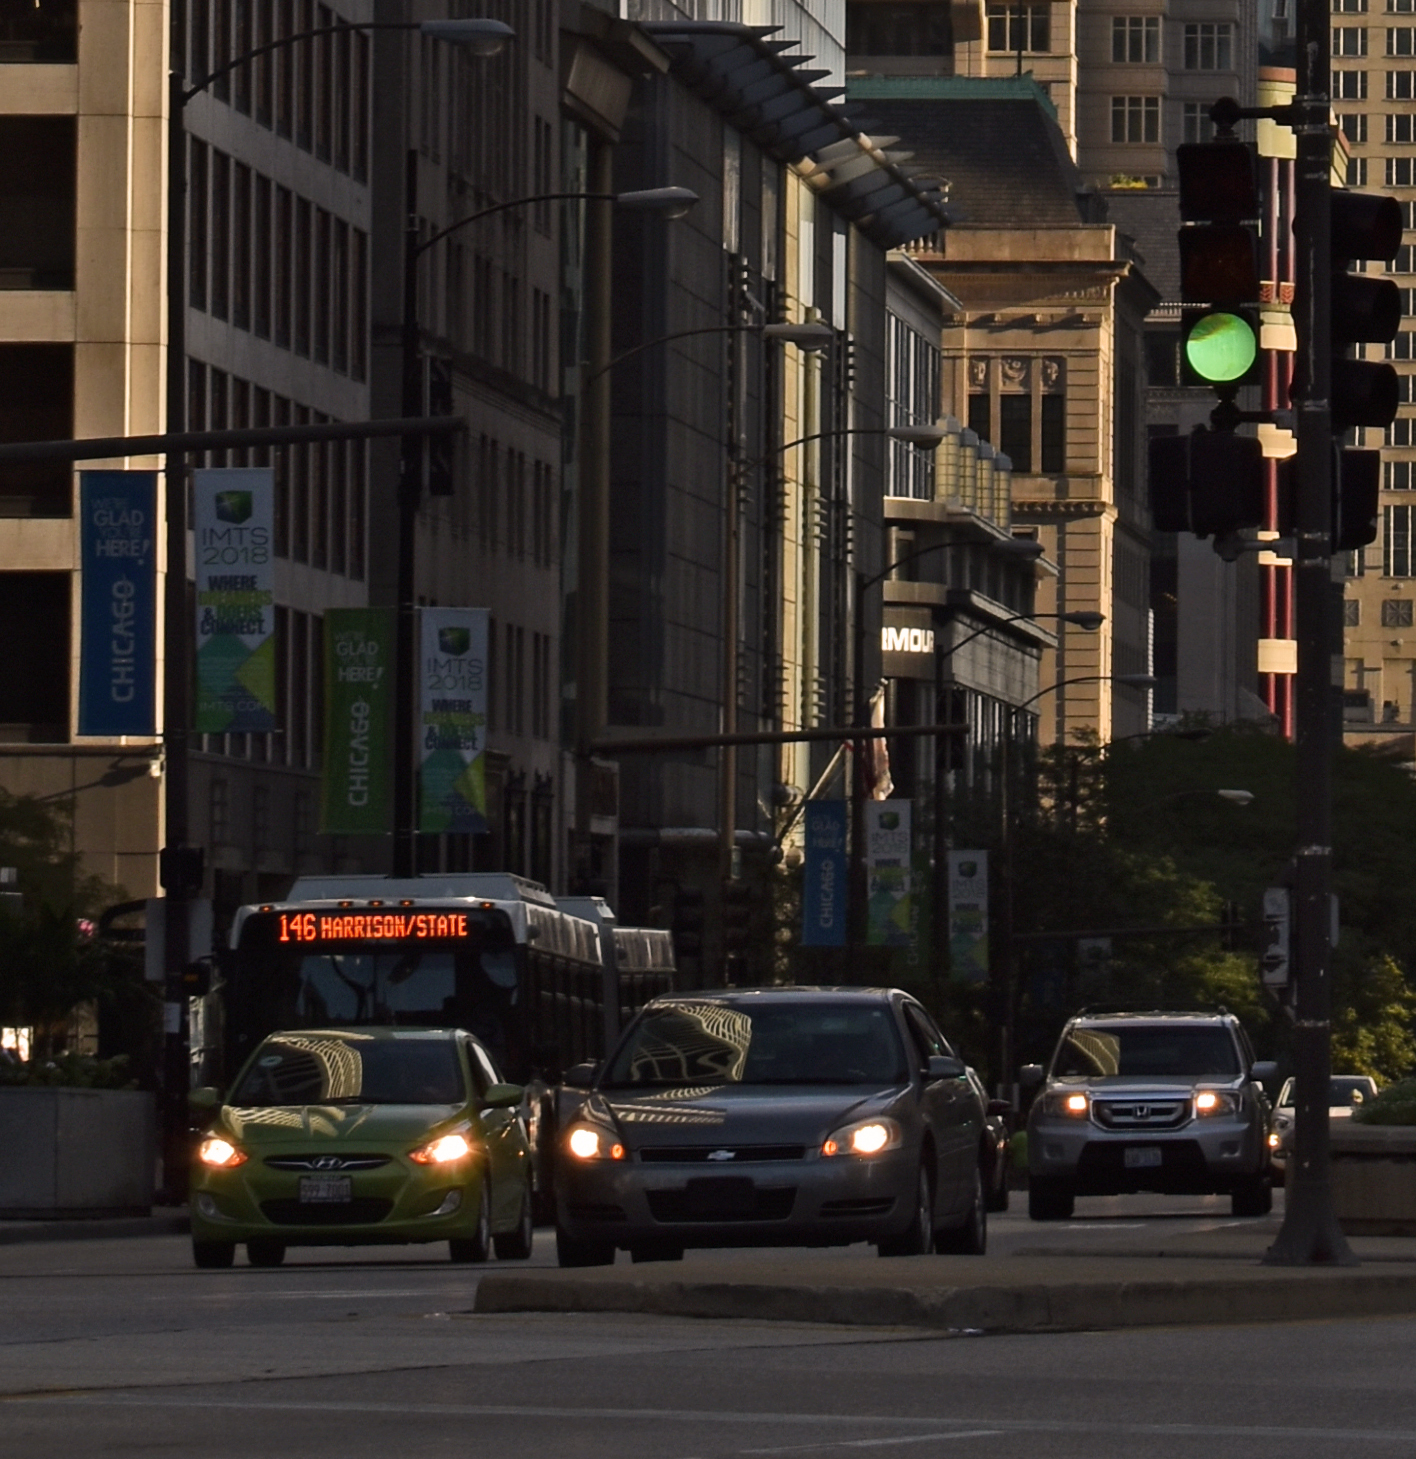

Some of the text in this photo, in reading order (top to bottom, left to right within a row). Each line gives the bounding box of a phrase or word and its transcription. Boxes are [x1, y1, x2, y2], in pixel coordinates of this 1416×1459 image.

[94, 510, 145, 526] GLAD
[203, 527, 268, 546] IMTS
[96, 539, 150, 566] HERE!
[203, 547, 269, 565] 2018
[208, 576, 257, 591] WHERE
[111, 575, 134, 702] CHICAGO
[336, 642, 379, 656] GLAD
[427, 658, 483, 675] IMTS
[429, 675, 483, 691] 2018
[348, 696, 370, 806] CHICAGO
[819, 859, 834, 928] CHICAGO
[280, 913, 468, 942] 146 HARRISON/STATE
